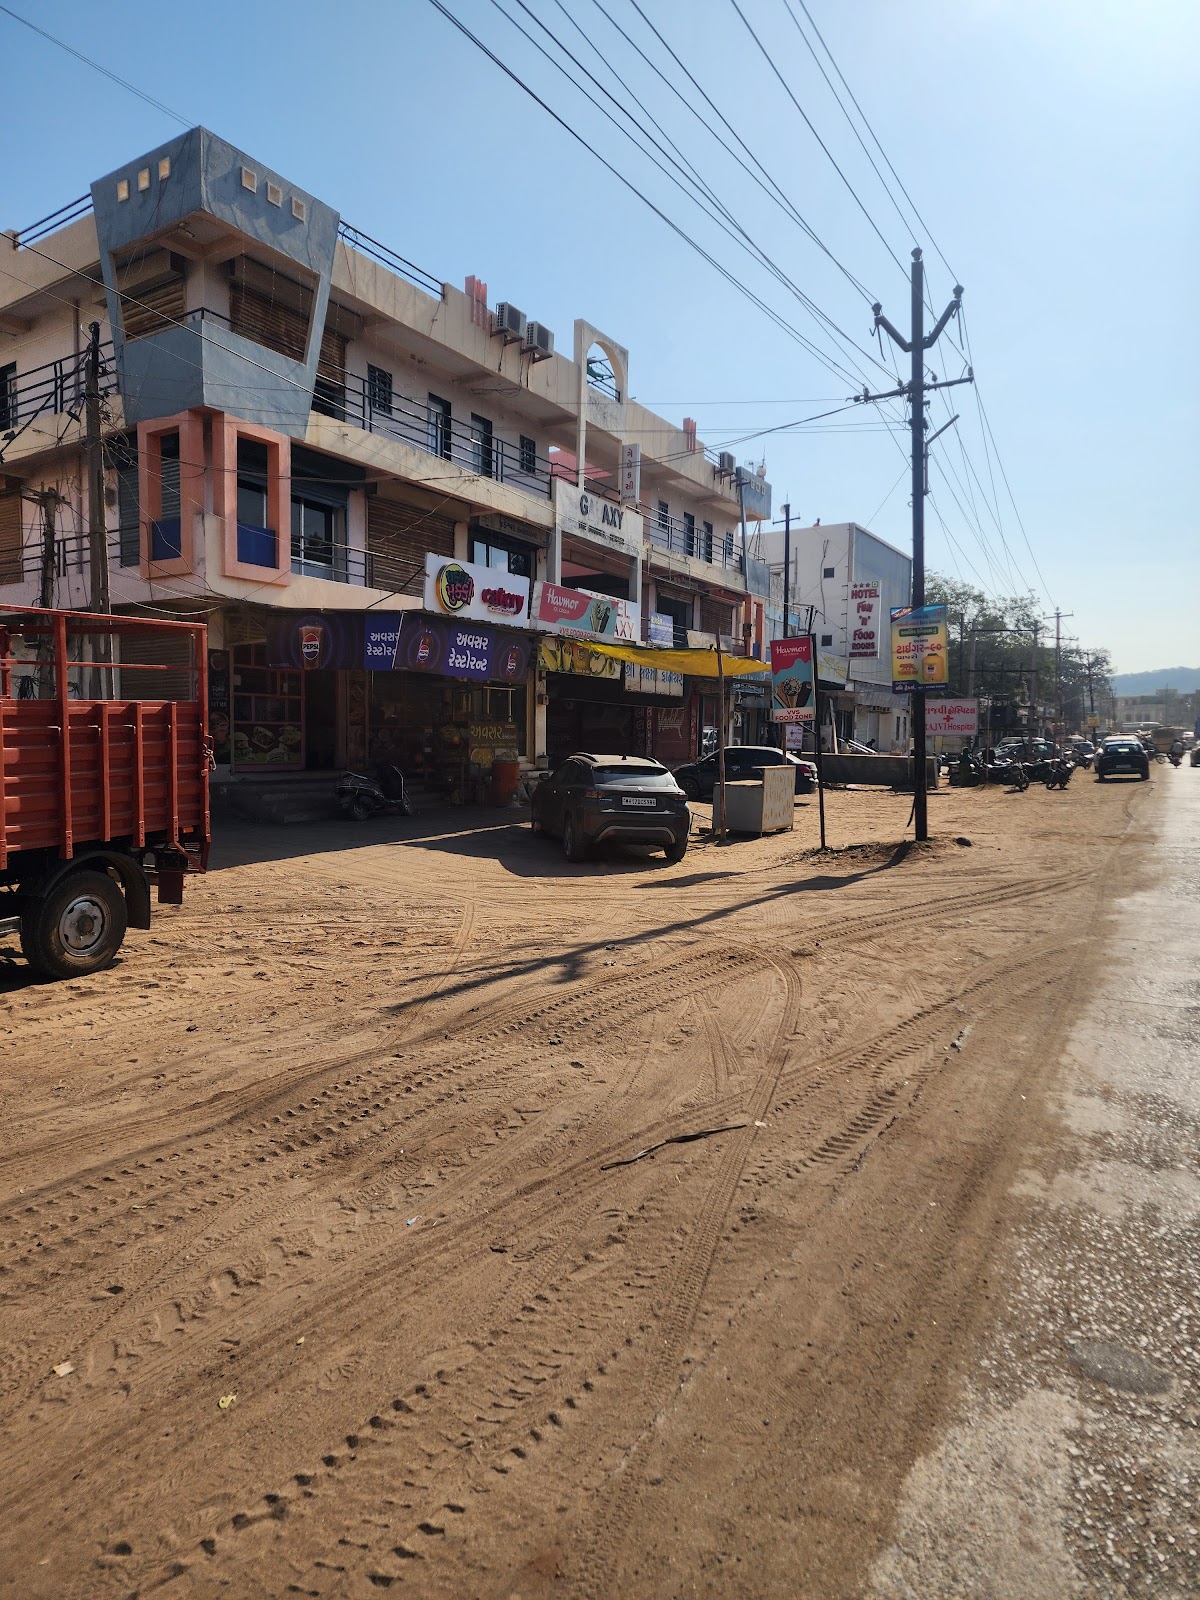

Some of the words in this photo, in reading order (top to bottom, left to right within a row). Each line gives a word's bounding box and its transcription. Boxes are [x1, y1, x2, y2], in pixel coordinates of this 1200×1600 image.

[547, 588, 579, 610] Havmor
[851, 589, 879, 600] HOTEL
[456, 632, 489, 651] અવસર
[852, 642, 875, 650] ROOMS
[775, 646, 807, 655] Havmor
[448, 647, 488, 671] રેસ્ટોરન્ટ
[925, 704, 947, 714] ાજવી
[470, 725, 503, 740] અવસર
[947, 723, 975, 732] Hospital
